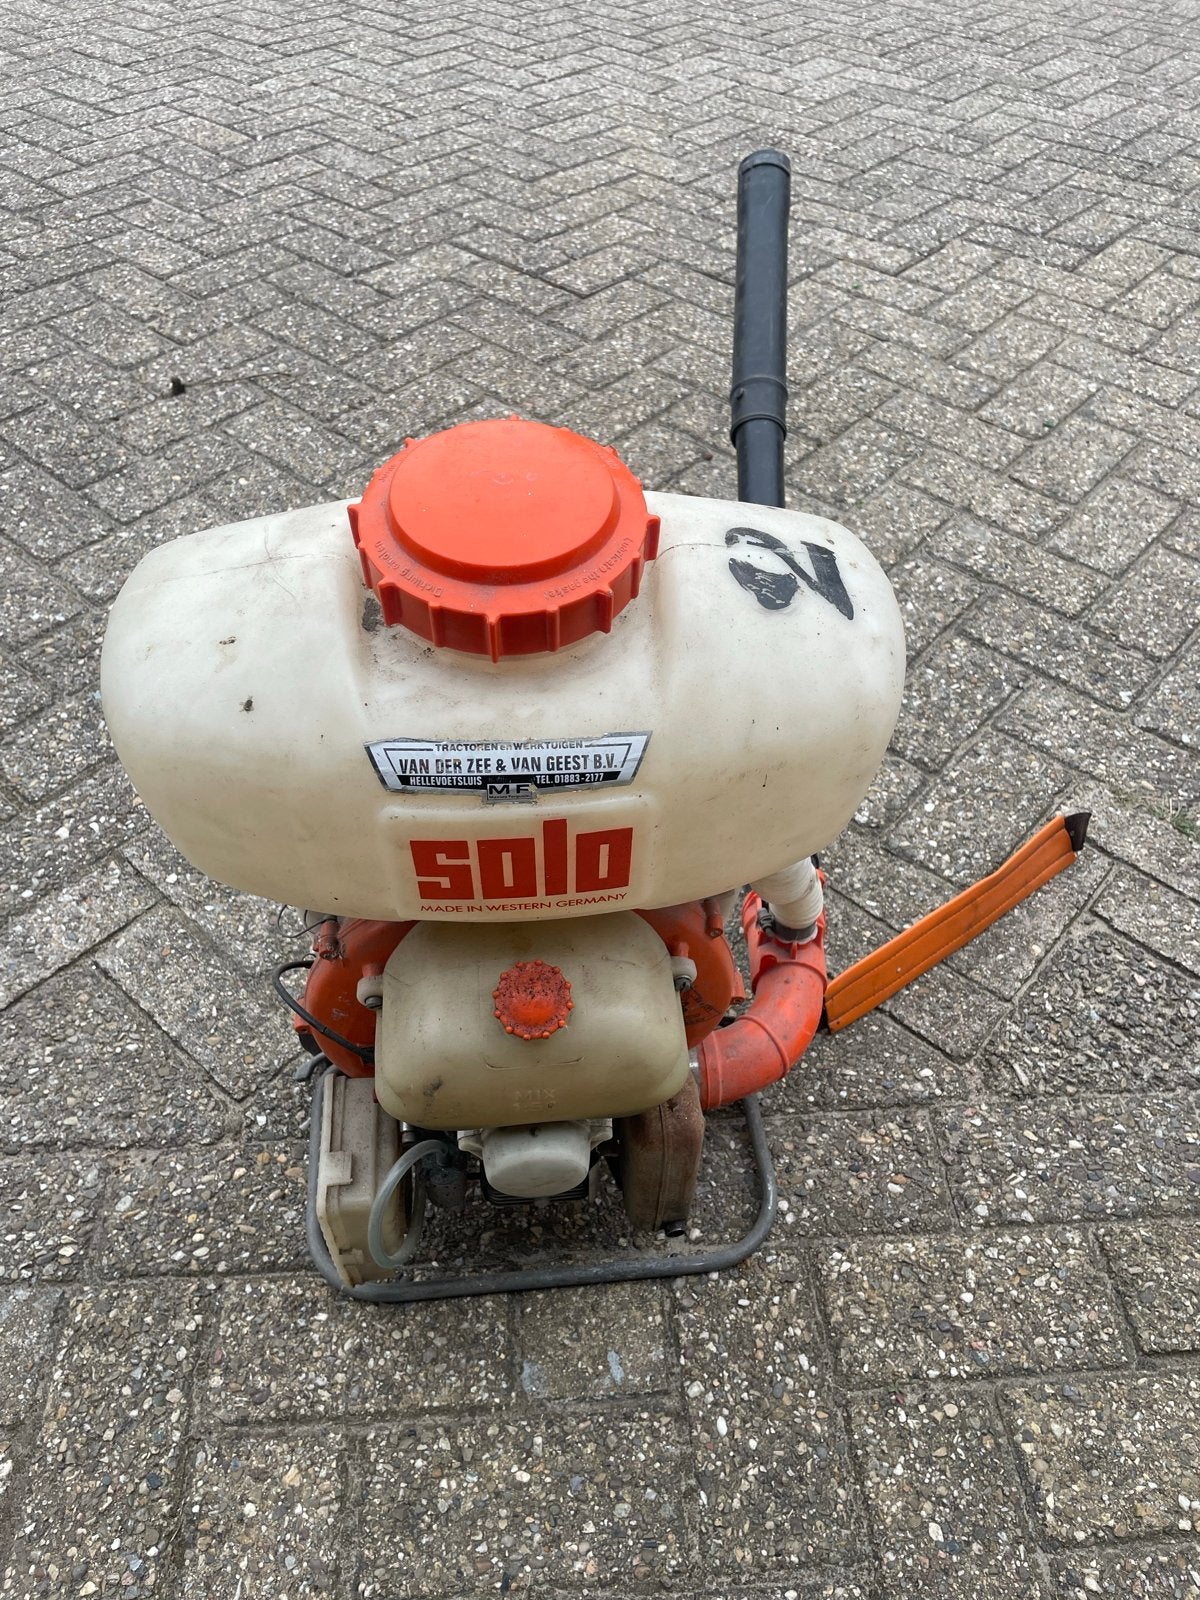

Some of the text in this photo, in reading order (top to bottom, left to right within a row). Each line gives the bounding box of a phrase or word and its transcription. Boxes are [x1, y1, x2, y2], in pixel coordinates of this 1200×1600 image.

[435, 743, 498, 752] TRACTOREN
[513, 740, 583, 750] WERKTUIGEN
[399, 753, 618, 774] VAN DER ZEE & VAN GEEST B.V.
[410, 776, 482, 786] HELLEVOETSLUIS
[409, 818, 633, 900] solo
[420, 892, 628, 913] MADE IN WESTERN GERMANY
